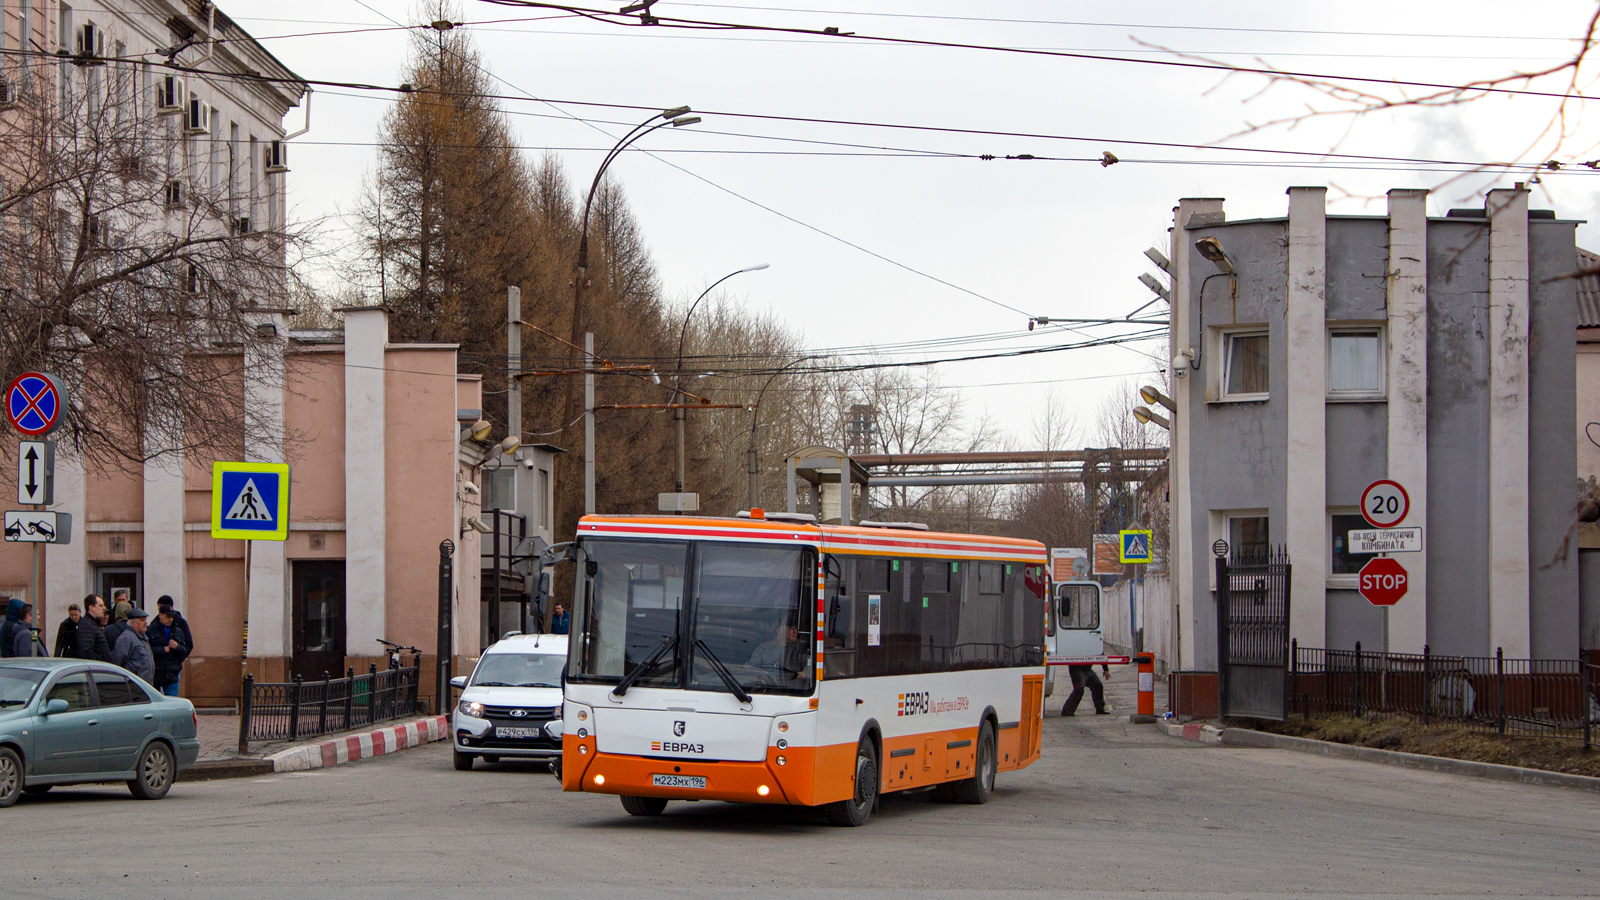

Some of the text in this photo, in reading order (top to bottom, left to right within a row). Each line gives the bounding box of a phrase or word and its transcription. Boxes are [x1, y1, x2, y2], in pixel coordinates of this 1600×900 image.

[1372, 495, 1399, 514] 20
[1363, 531, 1377, 541] ВСЕЙ
[1379, 530, 1415, 540] ТЕРРИТОРИИ
[1361, 540, 1405, 551] КОМБИНАТА
[1362, 574, 1406, 590] STOP
[904, 691, 930, 716] ЕВРАЗ
[663, 742, 705, 754] ЕВРАЗ
